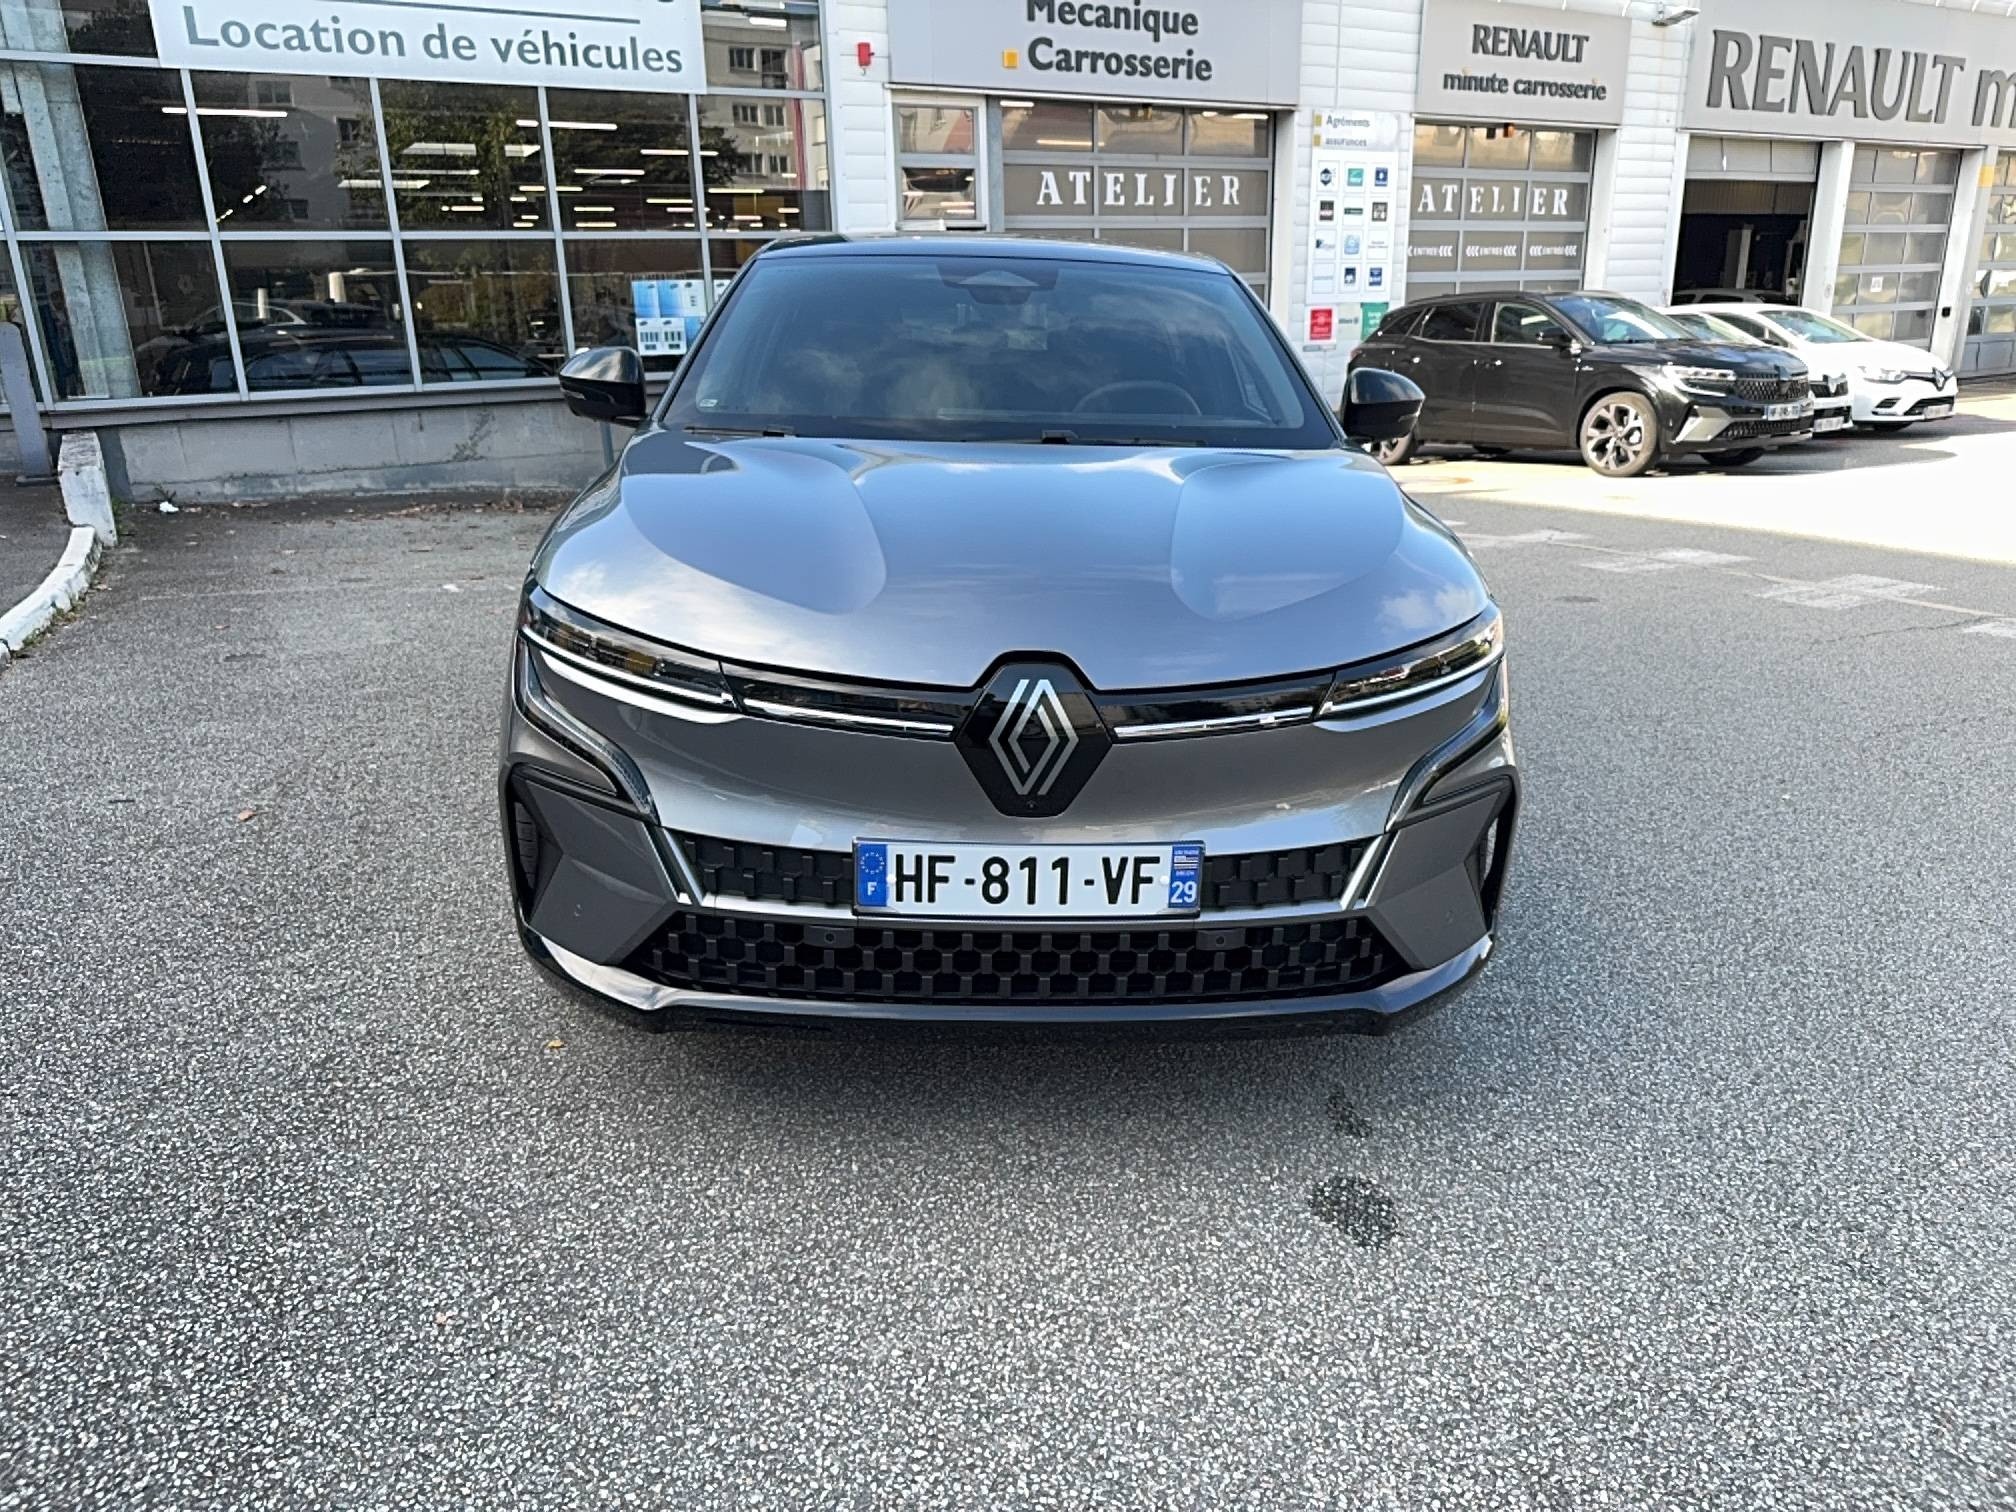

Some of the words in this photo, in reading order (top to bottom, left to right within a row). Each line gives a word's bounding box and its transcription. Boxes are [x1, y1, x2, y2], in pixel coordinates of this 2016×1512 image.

[183, 5, 405, 57] Location
[422, 24, 477, 61] de
[491, 31, 683, 73] véhicules
[1472, 24, 1590, 63] RENAULT
[1028, 36, 1212, 81] Carrosserie
[1706, 29, 1967, 124] RENAULT
[1443, 72, 1509, 93] minute
[1513, 78, 1607, 100] carrosserie
[1036, 171, 1240, 207] ATELIER
[1417, 183, 1569, 216] ATELIER
[867, 882, 878, 896] F
[895, 854, 1160, 905] HF-811-VF
[1170, 881, 1197, 904] 29
